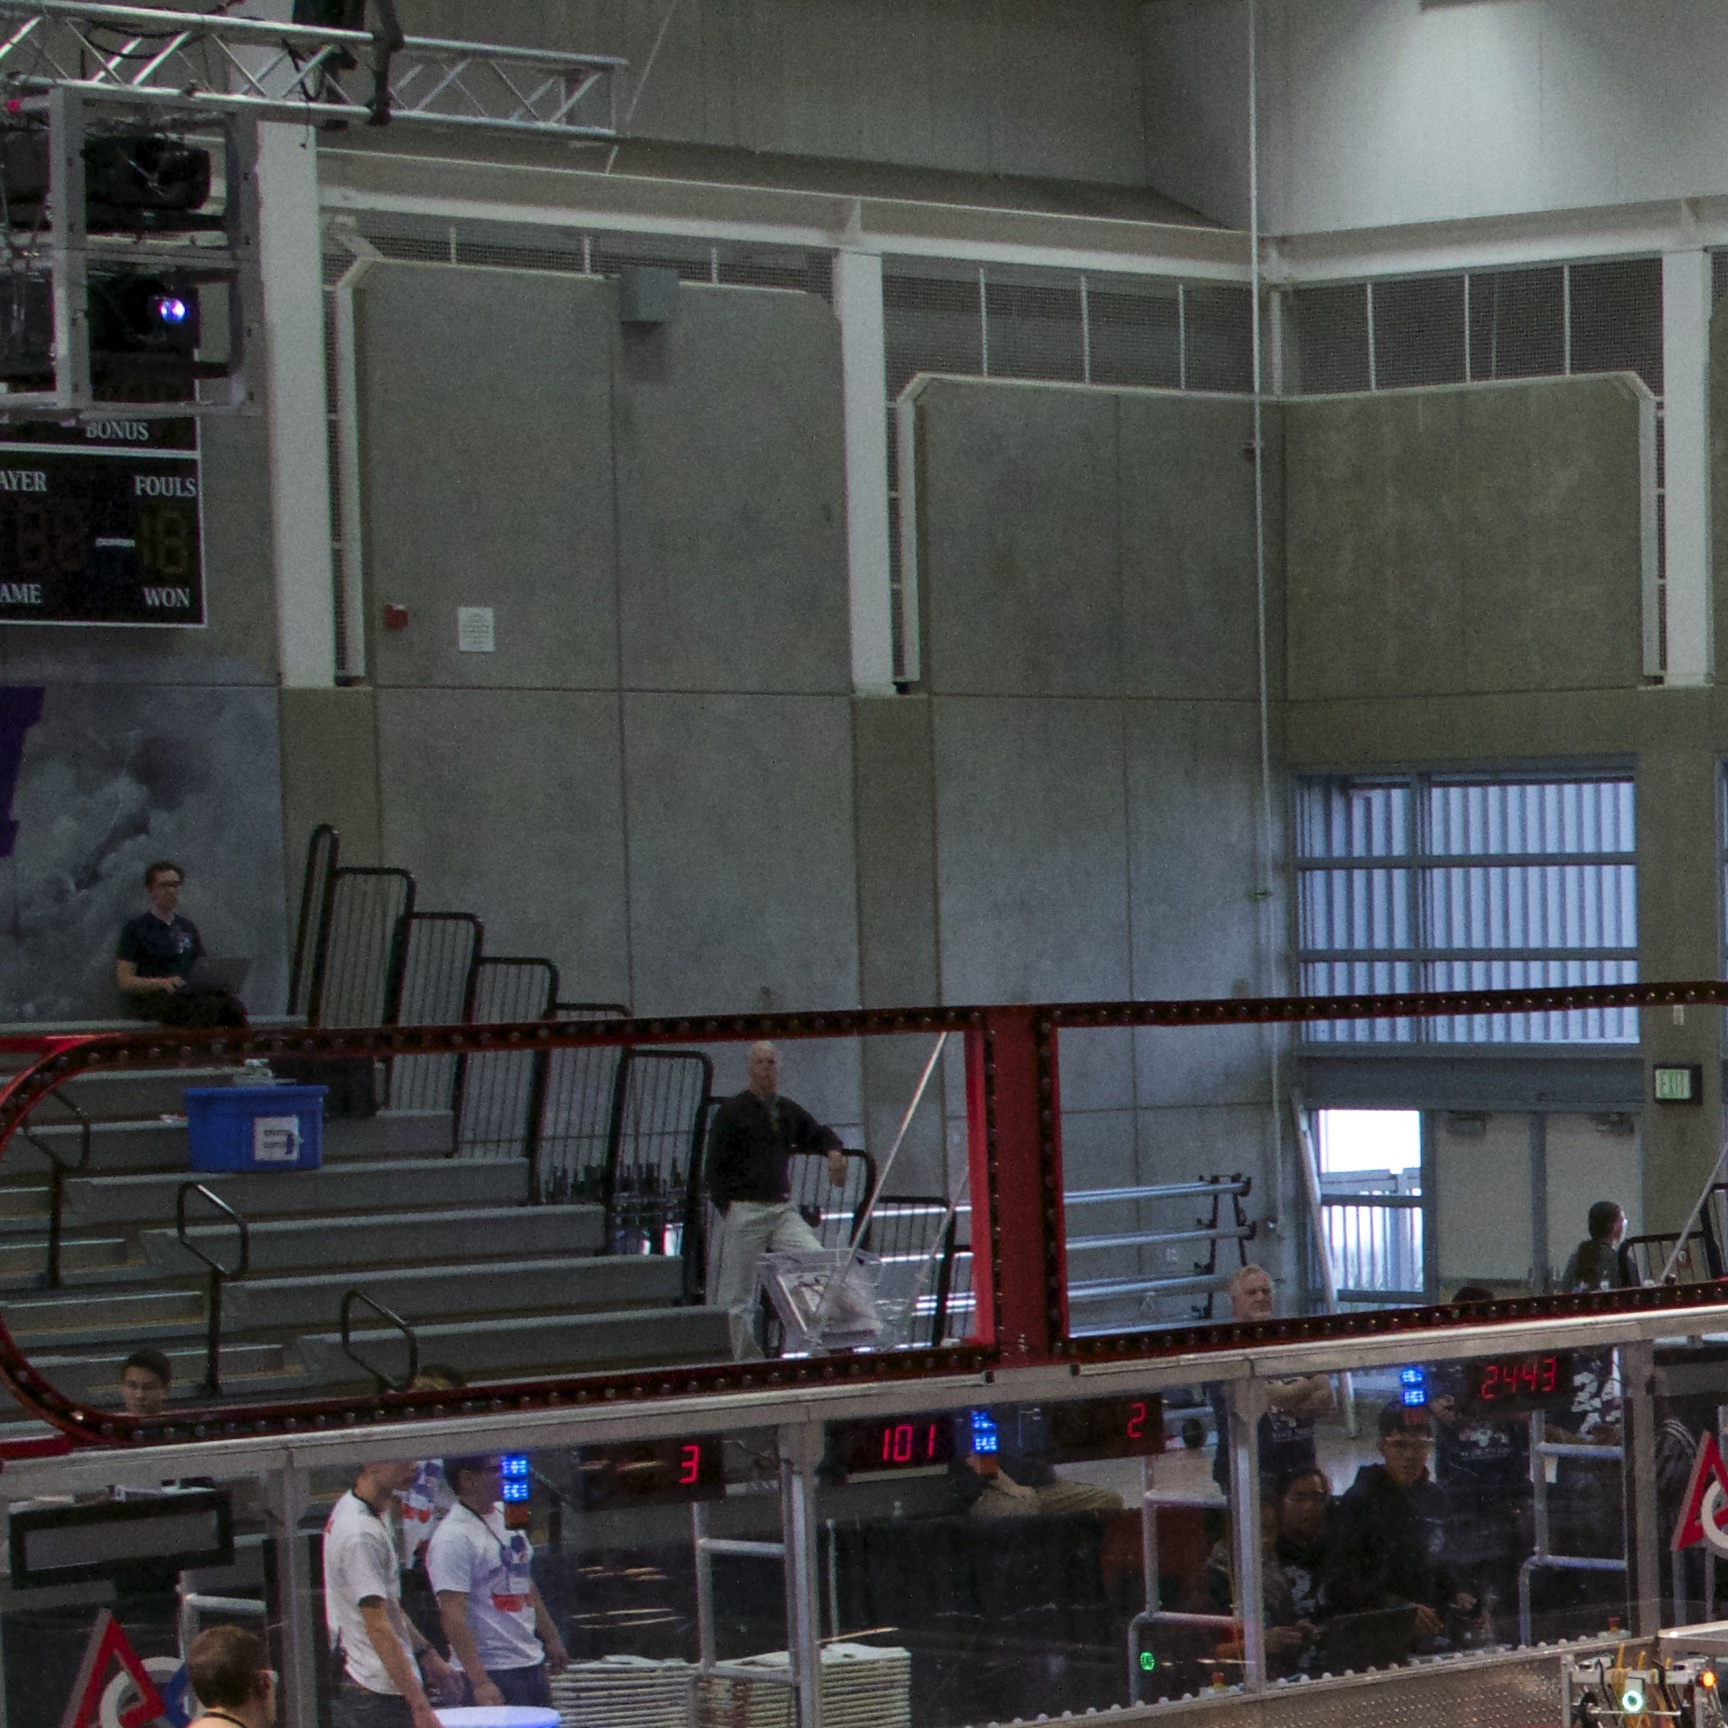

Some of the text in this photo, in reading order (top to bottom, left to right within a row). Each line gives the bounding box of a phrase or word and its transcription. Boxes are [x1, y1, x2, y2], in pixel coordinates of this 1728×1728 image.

[85, 421, 150, 441] BONUS
[134, 475, 198, 498] FOULS
[143, 587, 191, 608] WON
[1480, 1356, 1558, 1400] 2443
[1126, 1401, 1148, 1438] 2
[881, 1424, 936, 1463] 101
[678, 1444, 699, 1484] 3
